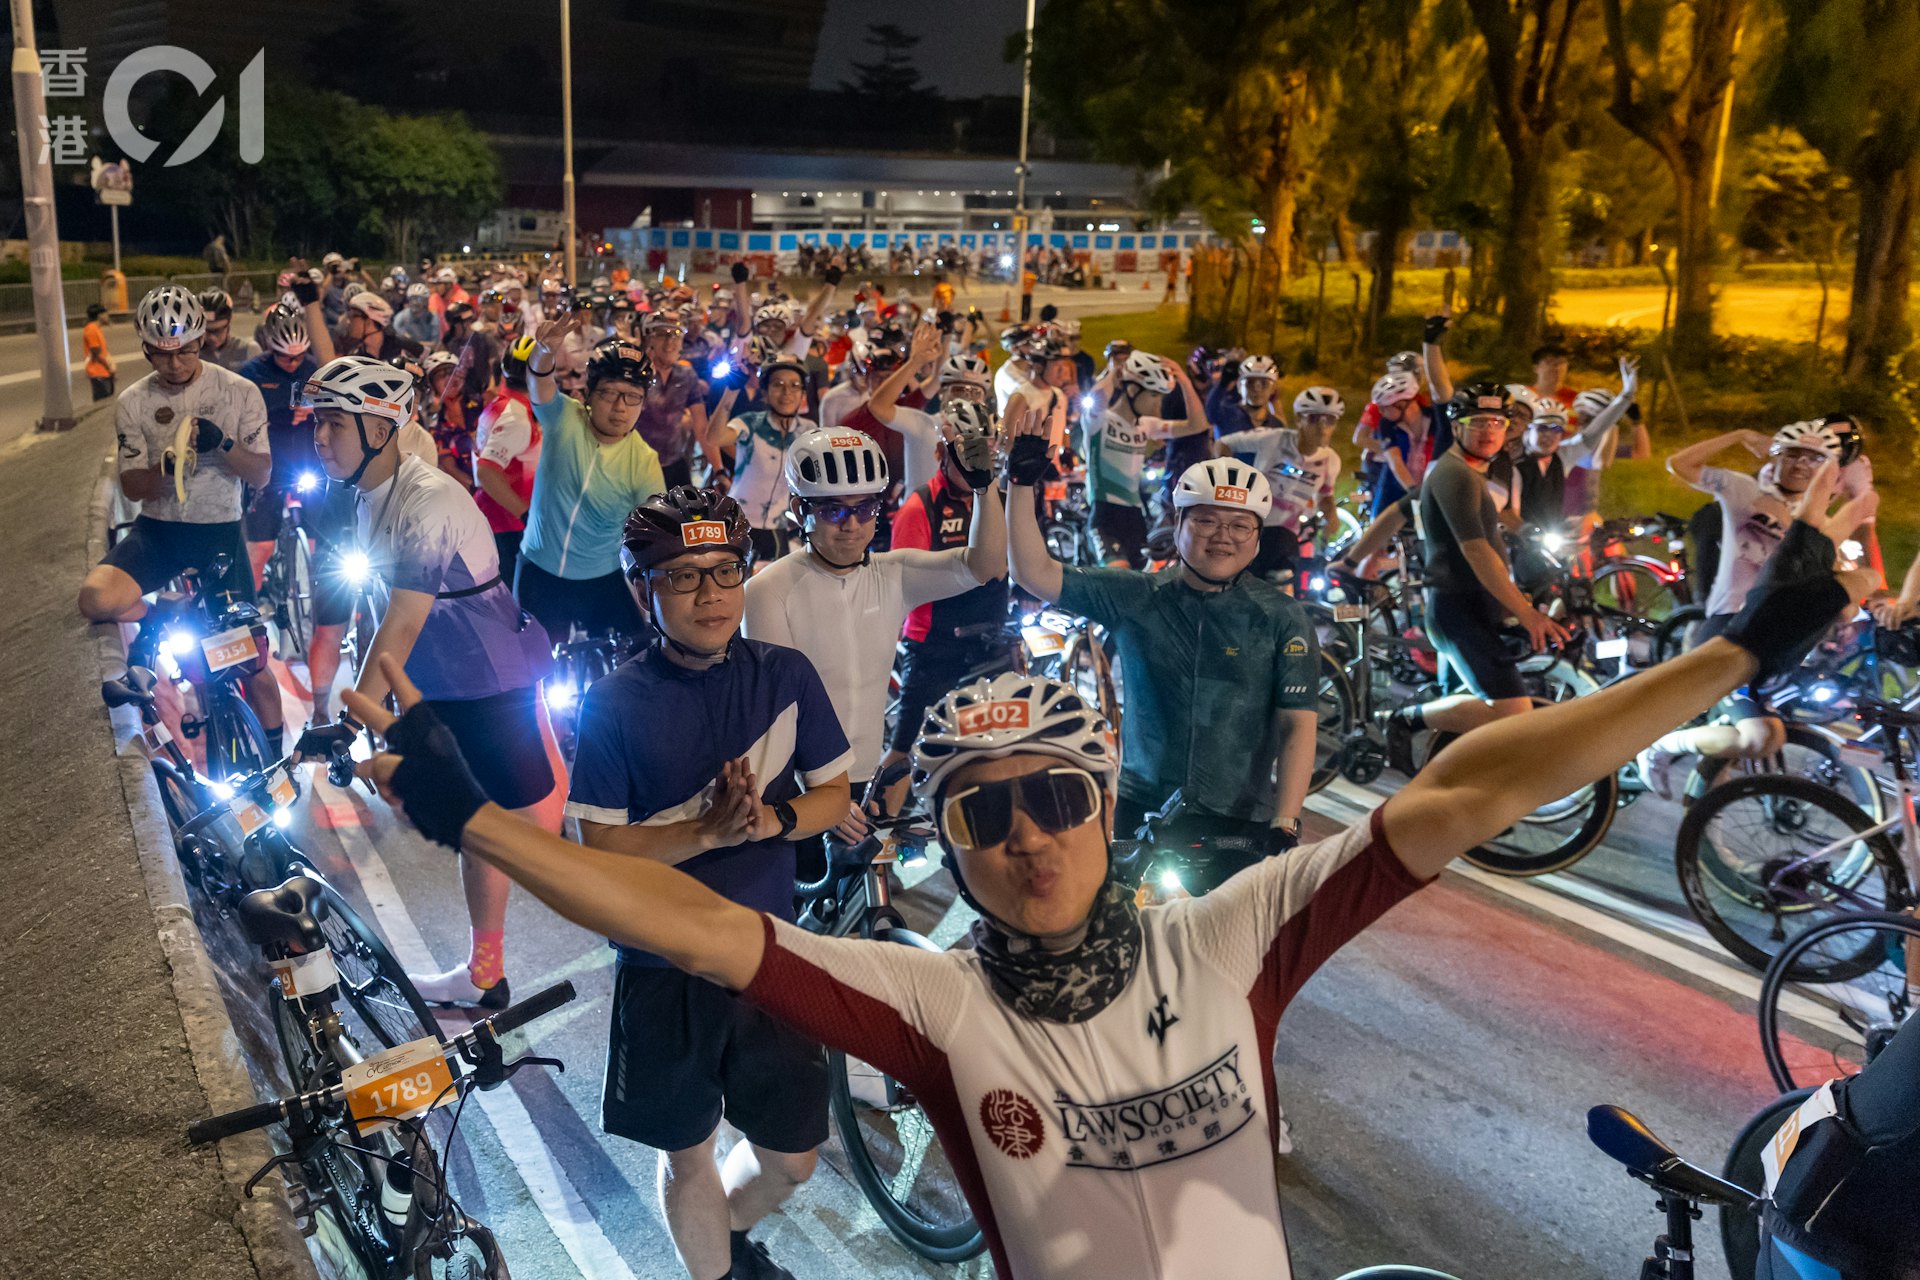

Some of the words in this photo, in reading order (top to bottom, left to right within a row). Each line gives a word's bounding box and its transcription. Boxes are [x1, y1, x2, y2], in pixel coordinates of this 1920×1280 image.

[833, 437, 860, 446] 1962
[1217, 488, 1245, 501] 2415
[688, 526, 722, 541] 1789
[215, 642, 248, 662] 3154
[965, 704, 1023, 729] 1102
[370, 1072, 433, 1114] 1789
[1150, 1114, 1198, 1138] HONG
[1210, 1083, 1247, 1115] KONG
